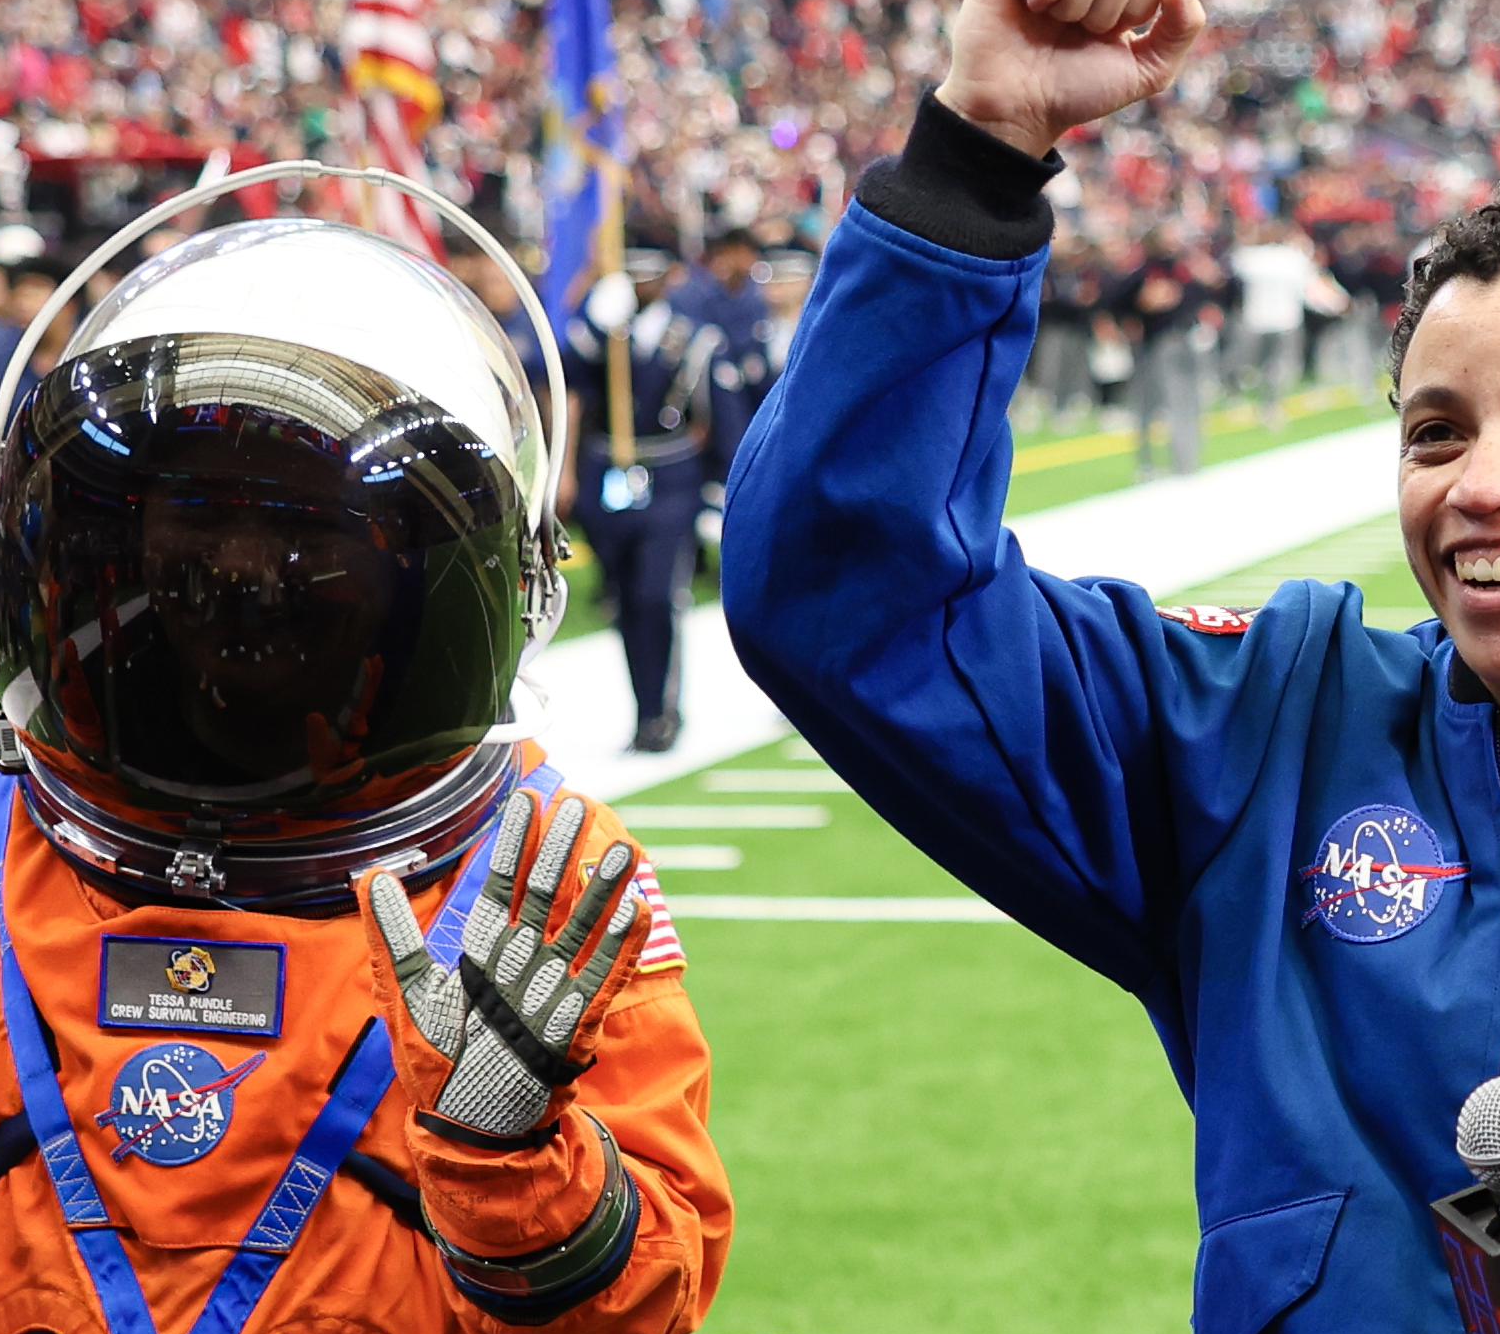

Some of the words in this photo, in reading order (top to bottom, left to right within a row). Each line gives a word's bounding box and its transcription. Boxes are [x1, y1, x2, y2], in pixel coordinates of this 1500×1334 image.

[1321, 842, 1428, 911] NASA
[111, 1004, 143, 1018] CREW
[148, 1007, 198, 1021] SURVIVAL
[203, 1011, 266, 1026] ENGINEERING
[149, 994, 184, 1006] TESSA
[190, 997, 232, 1010] RUNDLE
[120, 1085, 225, 1120] NASA
